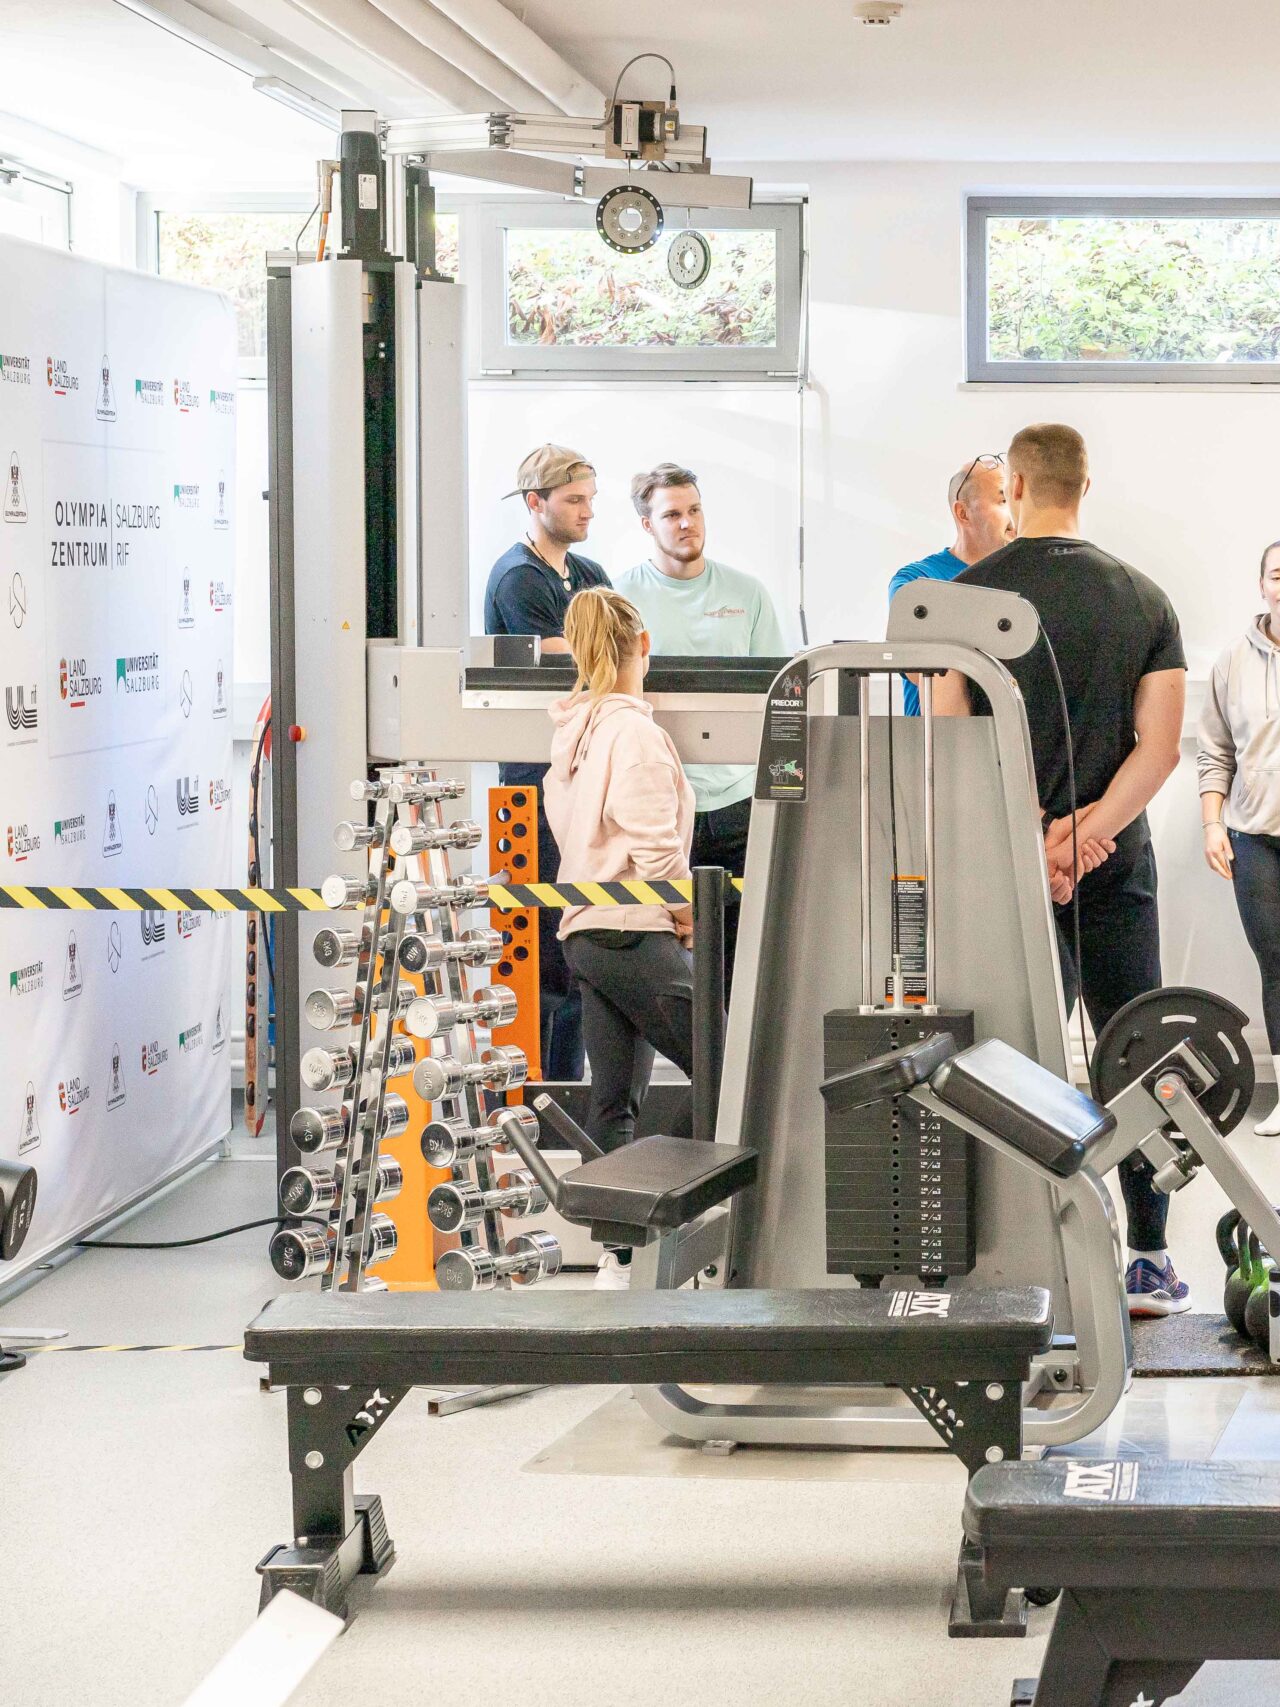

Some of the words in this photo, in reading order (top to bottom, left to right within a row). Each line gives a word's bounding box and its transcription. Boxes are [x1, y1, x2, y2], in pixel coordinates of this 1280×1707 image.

[3, 355, 30, 369] UNIVERSITÄT
[54, 358, 67, 373] LAND
[2, 370, 31, 385] SALZBURG
[54, 374, 79, 390] SALZBURG
[55, 500, 108, 528] OLYMPIA
[116, 503, 161, 529] SALZBURG
[51, 541, 108, 567] ZENTRUM
[116, 542, 130, 567] RIF
[69, 658, 87, 677] LAND
[126, 652, 159, 672] UNIVERSITÄT
[69, 677, 102, 697] SALZBURG
[126, 675, 160, 694] SALZBURG
[771, 699, 799, 707] PRECOR
[14, 824, 29, 839] LAND
[61, 813, 86, 831] UNIVERSITÄT
[15, 836, 41, 855] SALZBURG
[61, 829, 87, 845] SALZBURG
[17, 960, 43, 981] UNIVERSITÄT
[17, 976, 44, 996] SALZBURG
[66, 1077, 81, 1094] LAND
[67, 1085, 90, 1108] SALZBURG
[283, 1246, 294, 1268] 9KG
[908, 1291, 951, 1318] ATX
[1063, 1461, 1115, 1501] ATX
